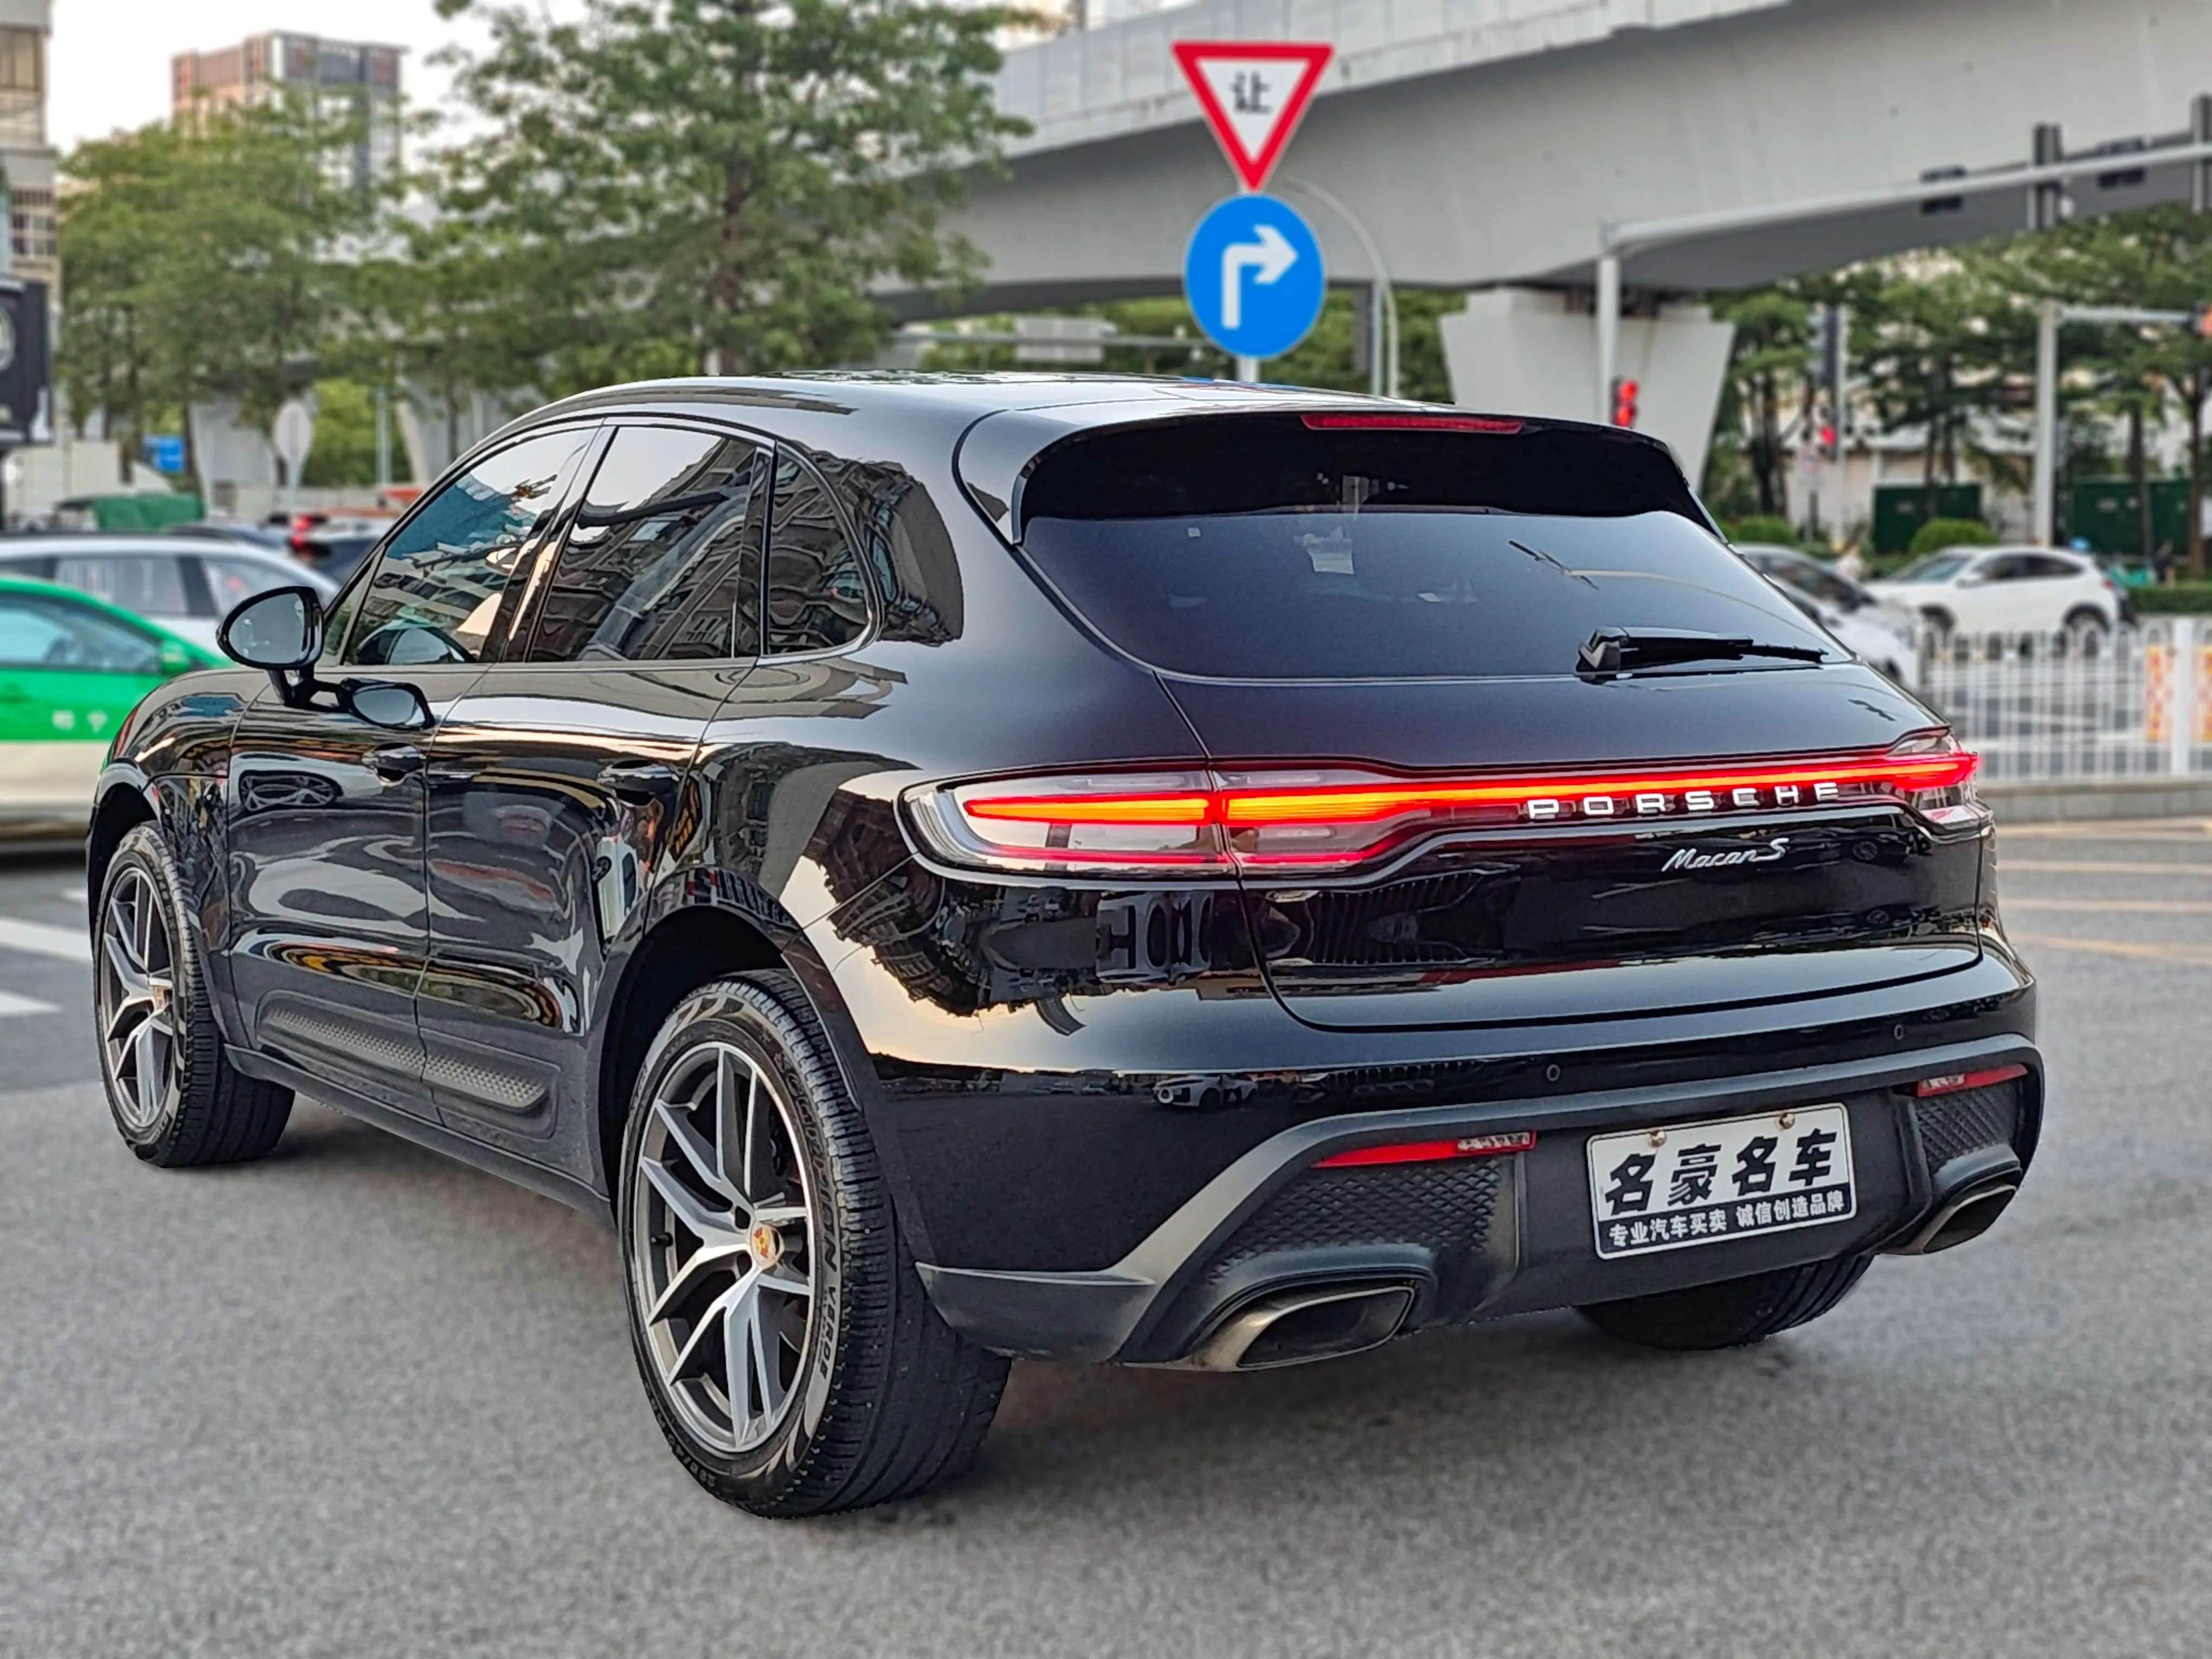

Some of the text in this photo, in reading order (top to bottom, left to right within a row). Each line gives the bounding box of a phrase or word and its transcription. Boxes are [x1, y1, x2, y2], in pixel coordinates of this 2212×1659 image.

[1227, 69, 1274, 113] 让
[1527, 781, 1840, 819] PORSCHE
[1661, 838, 1789, 872] Macan S
[1605, 1128, 1837, 1216] 名豪名车
[1609, 1189, 1845, 1247] 专业汽车买卖 诚信创造品牌
[820, 1286, 836, 1380] VERDE
